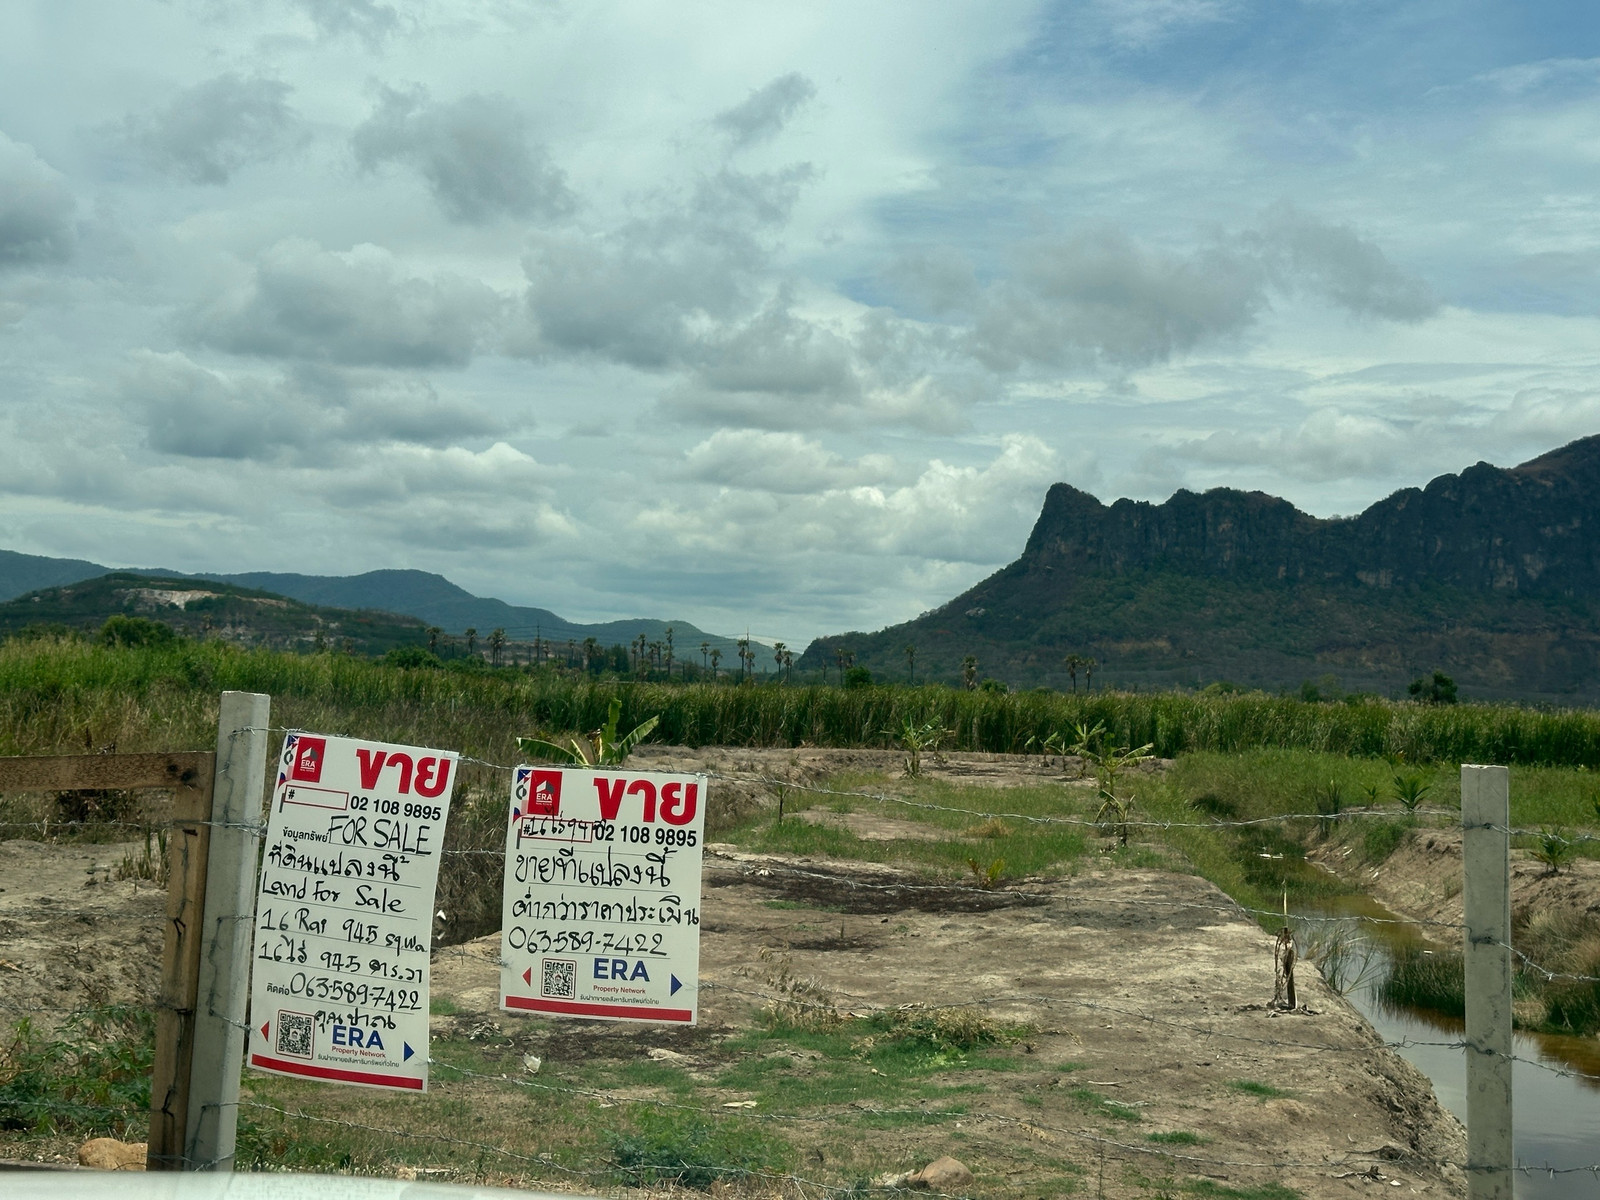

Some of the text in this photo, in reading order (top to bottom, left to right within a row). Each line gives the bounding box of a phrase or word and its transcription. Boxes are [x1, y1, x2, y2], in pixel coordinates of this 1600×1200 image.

[301, 759, 315, 768] ERA
[356, 748, 451, 798] ขาย
[351, 796, 441, 821] 02 108 9895
[593, 777, 698, 825] ขาย
[283, 826, 329, 844] ข้อมูลทรัพย์
[328, 815, 432, 855] FOR SALE
[595, 824, 614, 841] 02
[621, 826, 650, 843] 108
[655, 828, 697, 847] 9895
[262, 871, 307, 899] Land
[355, 885, 406, 913] Sale
[260, 909, 289, 931] 16
[295, 908, 327, 934] Rai
[594, 958, 650, 982] ERA
[266, 983, 289, 995] ติดต่อ
[593, 985, 619, 993] Property
[332, 1024, 384, 1050] ERA
[332, 1046, 386, 1058] Property Network
